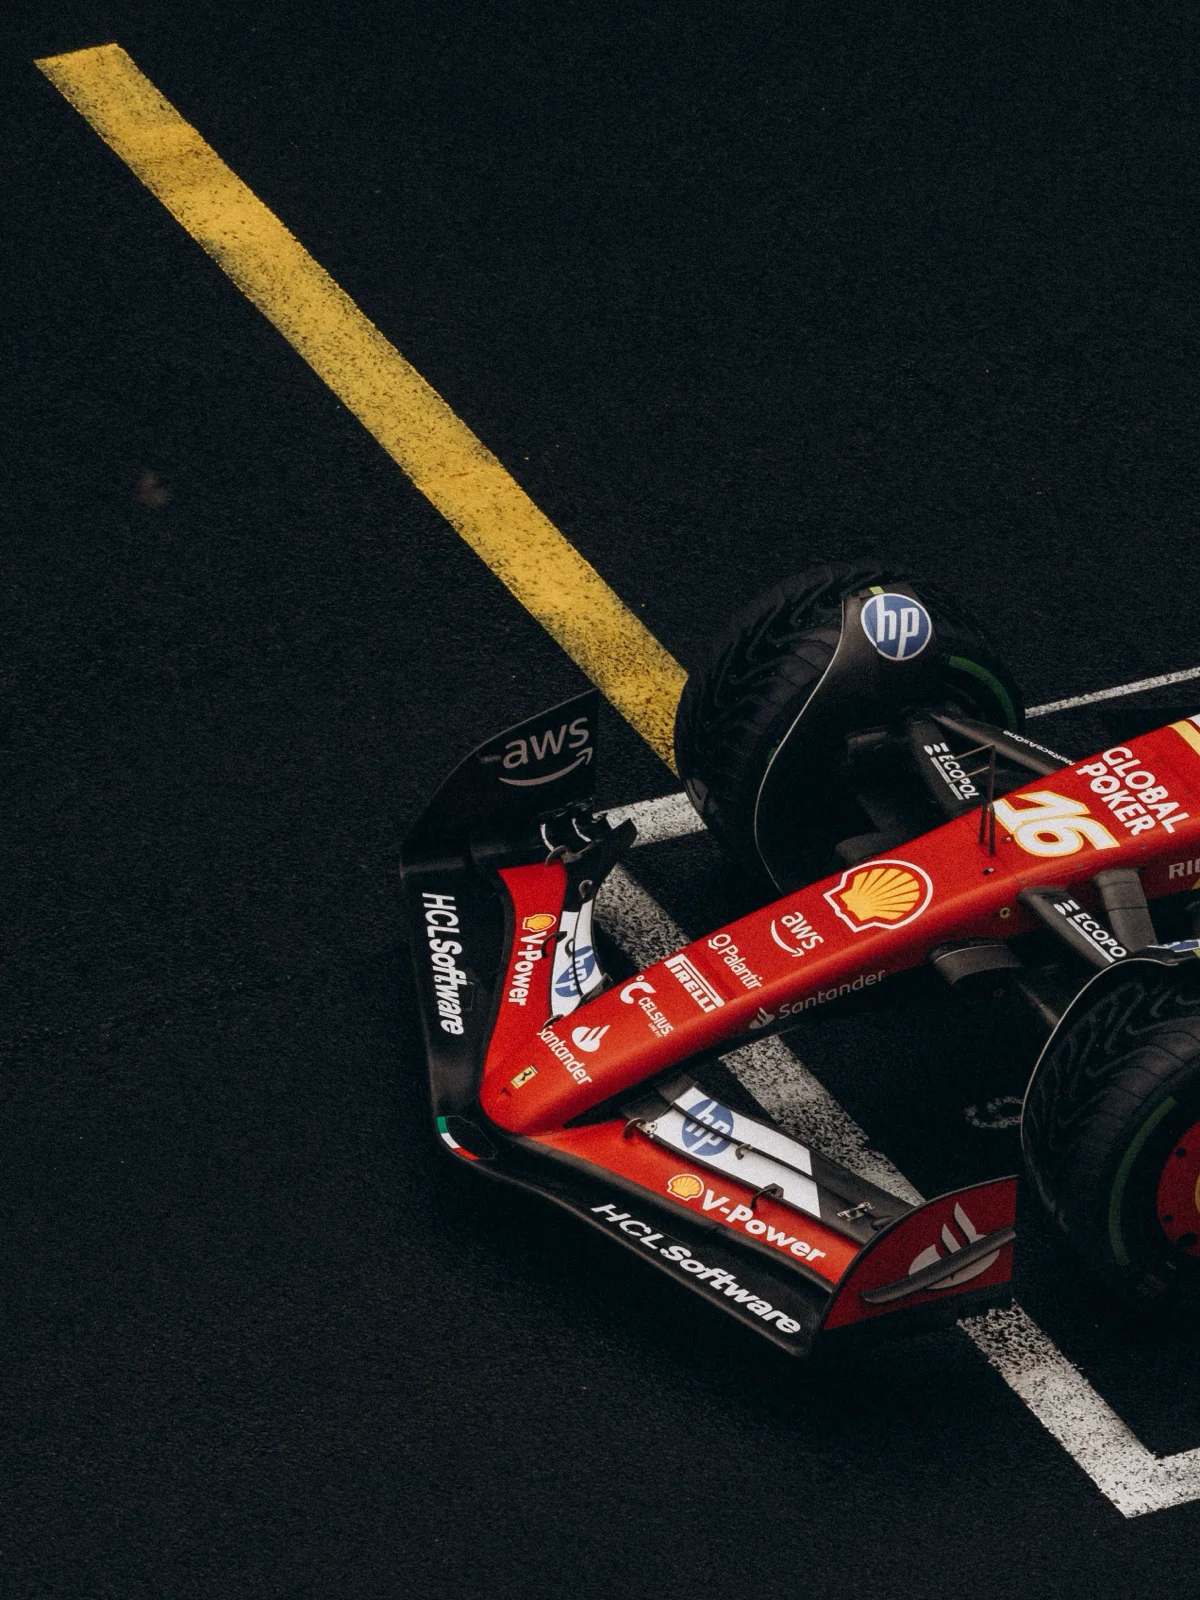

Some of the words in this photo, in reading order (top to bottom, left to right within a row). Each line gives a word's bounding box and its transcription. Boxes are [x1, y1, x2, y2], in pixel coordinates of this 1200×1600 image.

[876, 594, 920, 659] hp
[502, 717, 590, 770] aws
[938, 754, 980, 800] ECOPOL
[1075, 763, 1156, 837] POKER
[1102, 745, 1193, 835] GLOBAL
[992, 789, 1121, 858] 16
[780, 910, 825, 951] aws
[508, 930, 548, 1006] V-Power
[663, 953, 726, 1014] PIRELLI
[716, 947, 764, 991] Palantir
[778, 968, 887, 1019] Santander
[536, 1025, 593, 1086] Santander
[702, 1190, 827, 1277] V-Power
